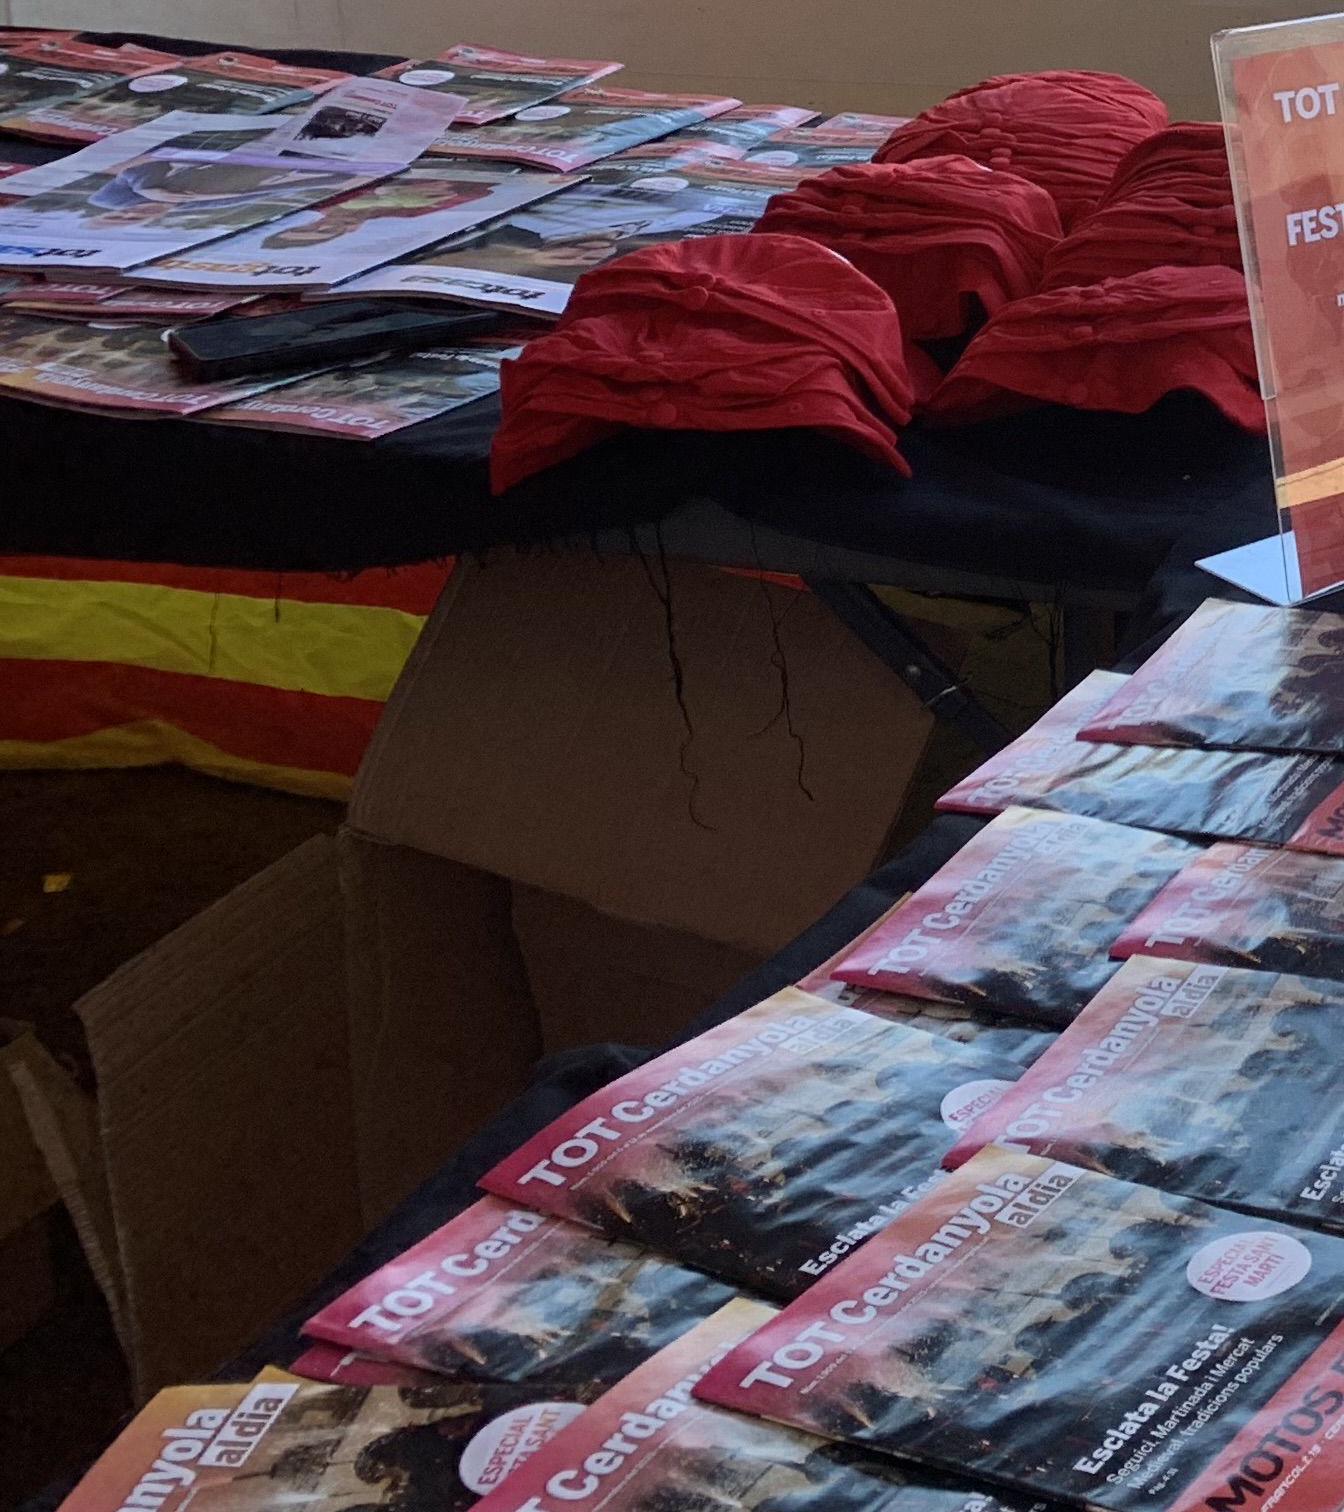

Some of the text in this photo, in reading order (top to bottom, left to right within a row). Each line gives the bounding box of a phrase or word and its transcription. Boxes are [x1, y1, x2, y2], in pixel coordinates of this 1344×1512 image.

[1274, 83, 1341, 123] TOT
[335, 415, 390, 430] TOT
[867, 819, 1050, 976] TOT Cerdanyola
[1145, 907, 1201, 948] TOT
[994, 975, 1183, 1153] TOT Cerdanyola
[517, 1011, 819, 1188] TOT Cerdanyola
[1007, 1173, 1075, 1228] al dia
[798, 1214, 890, 1277] Esclata
[1198, 1239, 1248, 1286] ESPECIAL
[1210, 1238, 1280, 1295] FESTA SANT
[350, 1271, 461, 1333] TOT
[738, 1173, 1032, 1389] TOT Cerdanyola
[1073, 1324, 1235, 1475] Esclata la Festa!
[1151, 1337, 1255, 1440] Martinada Mercat
[1185, 1333, 1284, 1437] tradicions populars
[216, 1397, 283, 1465] al dia
[477, 1411, 535, 1487] ESPECIAL
[517, 1409, 564, 1453] SANT
[1205, 1385, 1344, 1512] MOTOS
